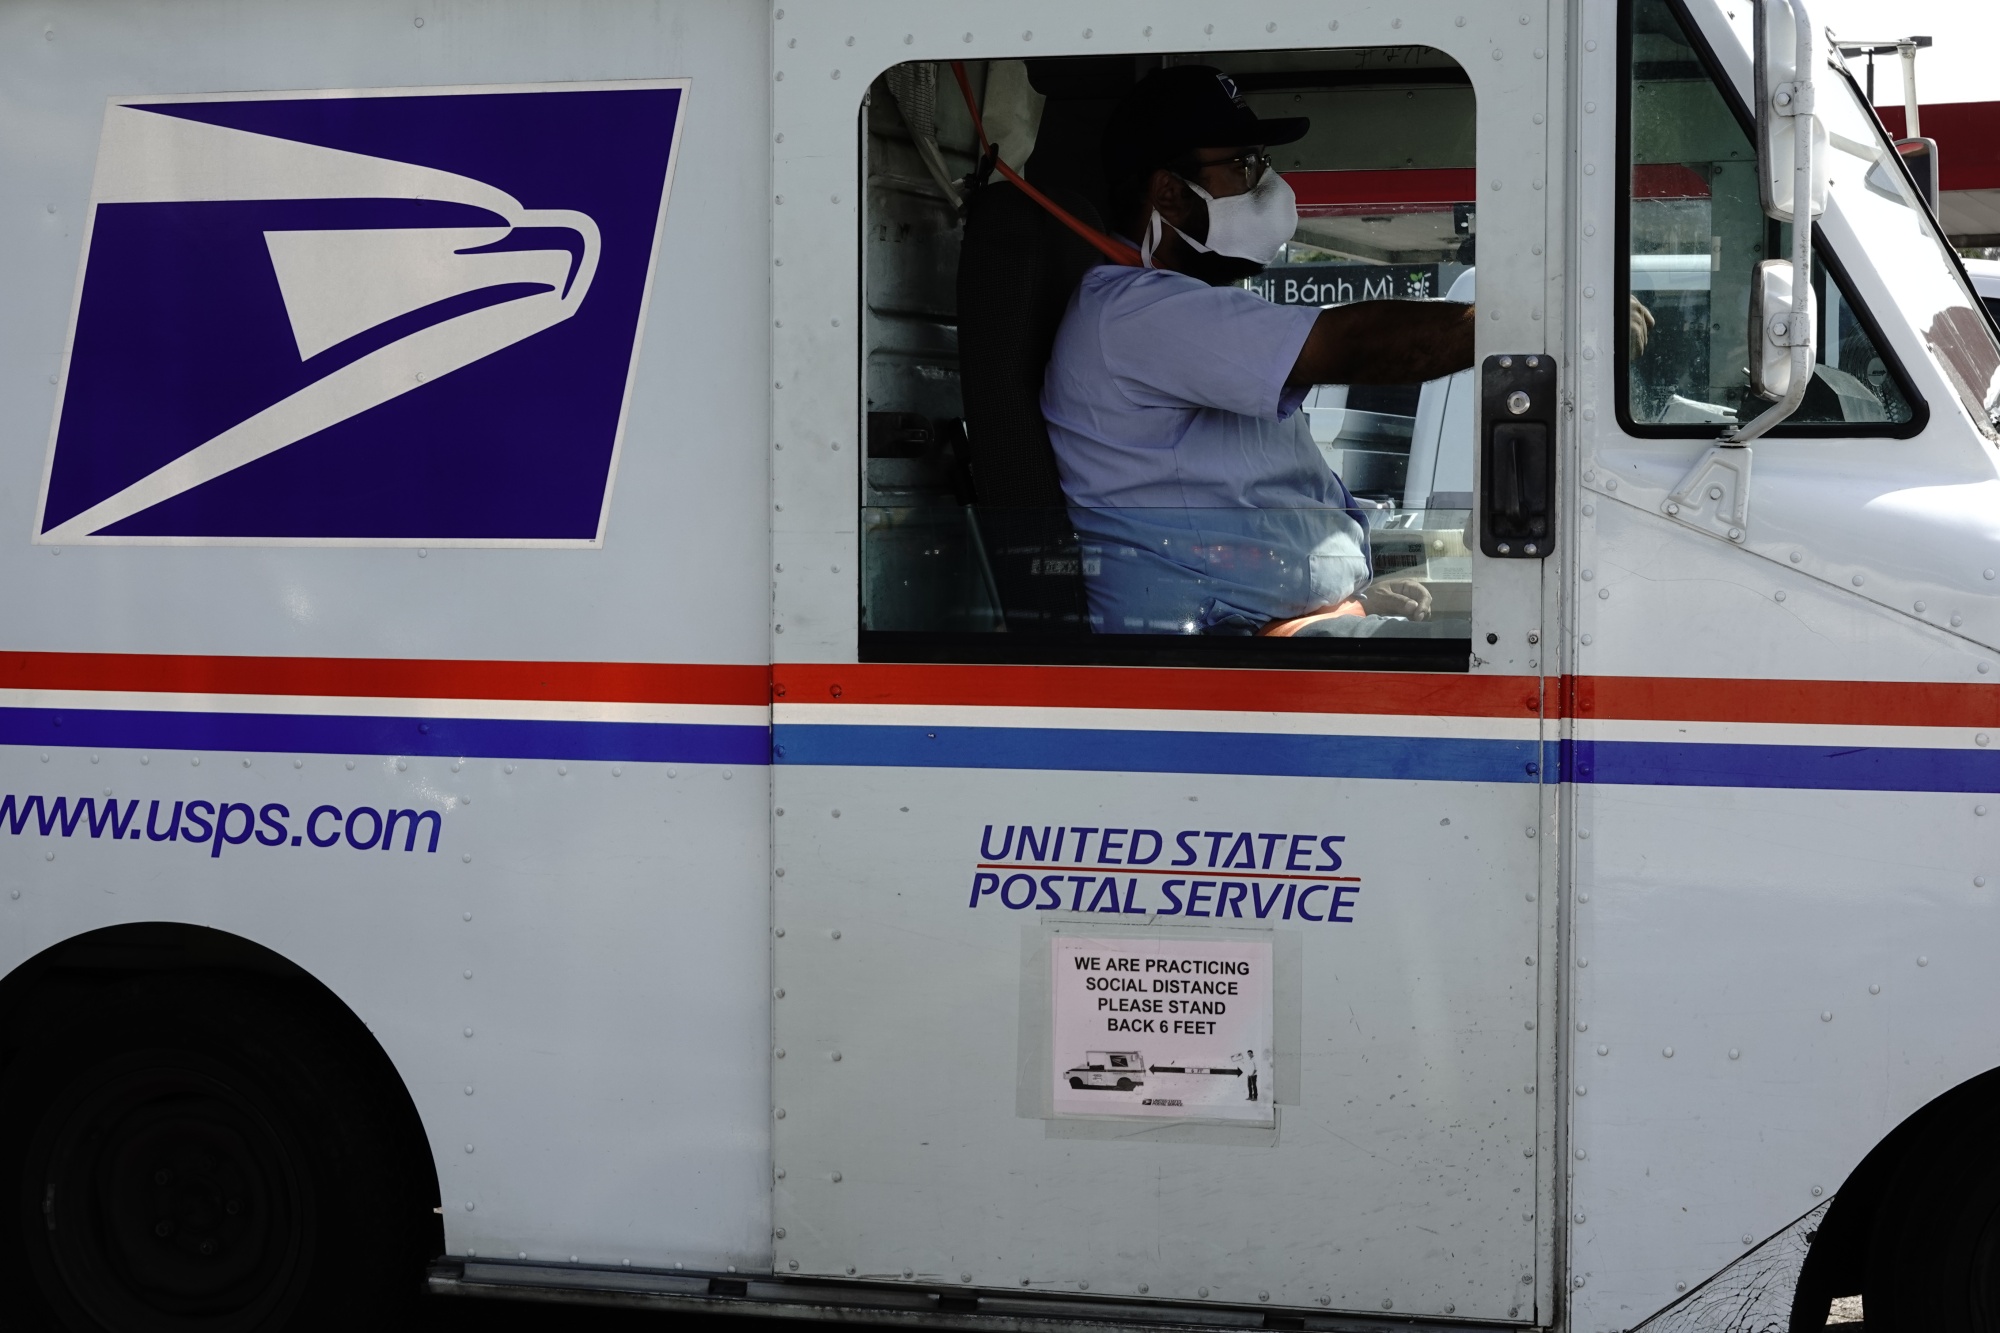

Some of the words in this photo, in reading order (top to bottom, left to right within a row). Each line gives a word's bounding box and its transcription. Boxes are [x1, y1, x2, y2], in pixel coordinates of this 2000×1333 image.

[1285, 276, 1353, 303] Bánh
[1362, 274, 1394, 300] Mì
[0, 795, 442, 858] www.usps.com
[980, 825, 1163, 865] UNITED
[1171, 830, 1345, 872] STATES
[969, 873, 1146, 914] POSTAL
[1156, 879, 1360, 923] SERVICE
[1074, 956, 1101, 971] WE
[1105, 957, 1141, 972] ARE
[1145, 958, 1250, 976] PRACTICING
[1085, 976, 1148, 993] SOCIAL
[1152, 979, 1239, 996] DISTANCE
[1098, 997, 1164, 1013] PLEASE
[1168, 999, 1226, 1015] STAND
[1107, 1017, 1155, 1033] BACK
[1159, 1019, 1169, 1034] 6
[1173, 1020, 1217, 1035] FEET
